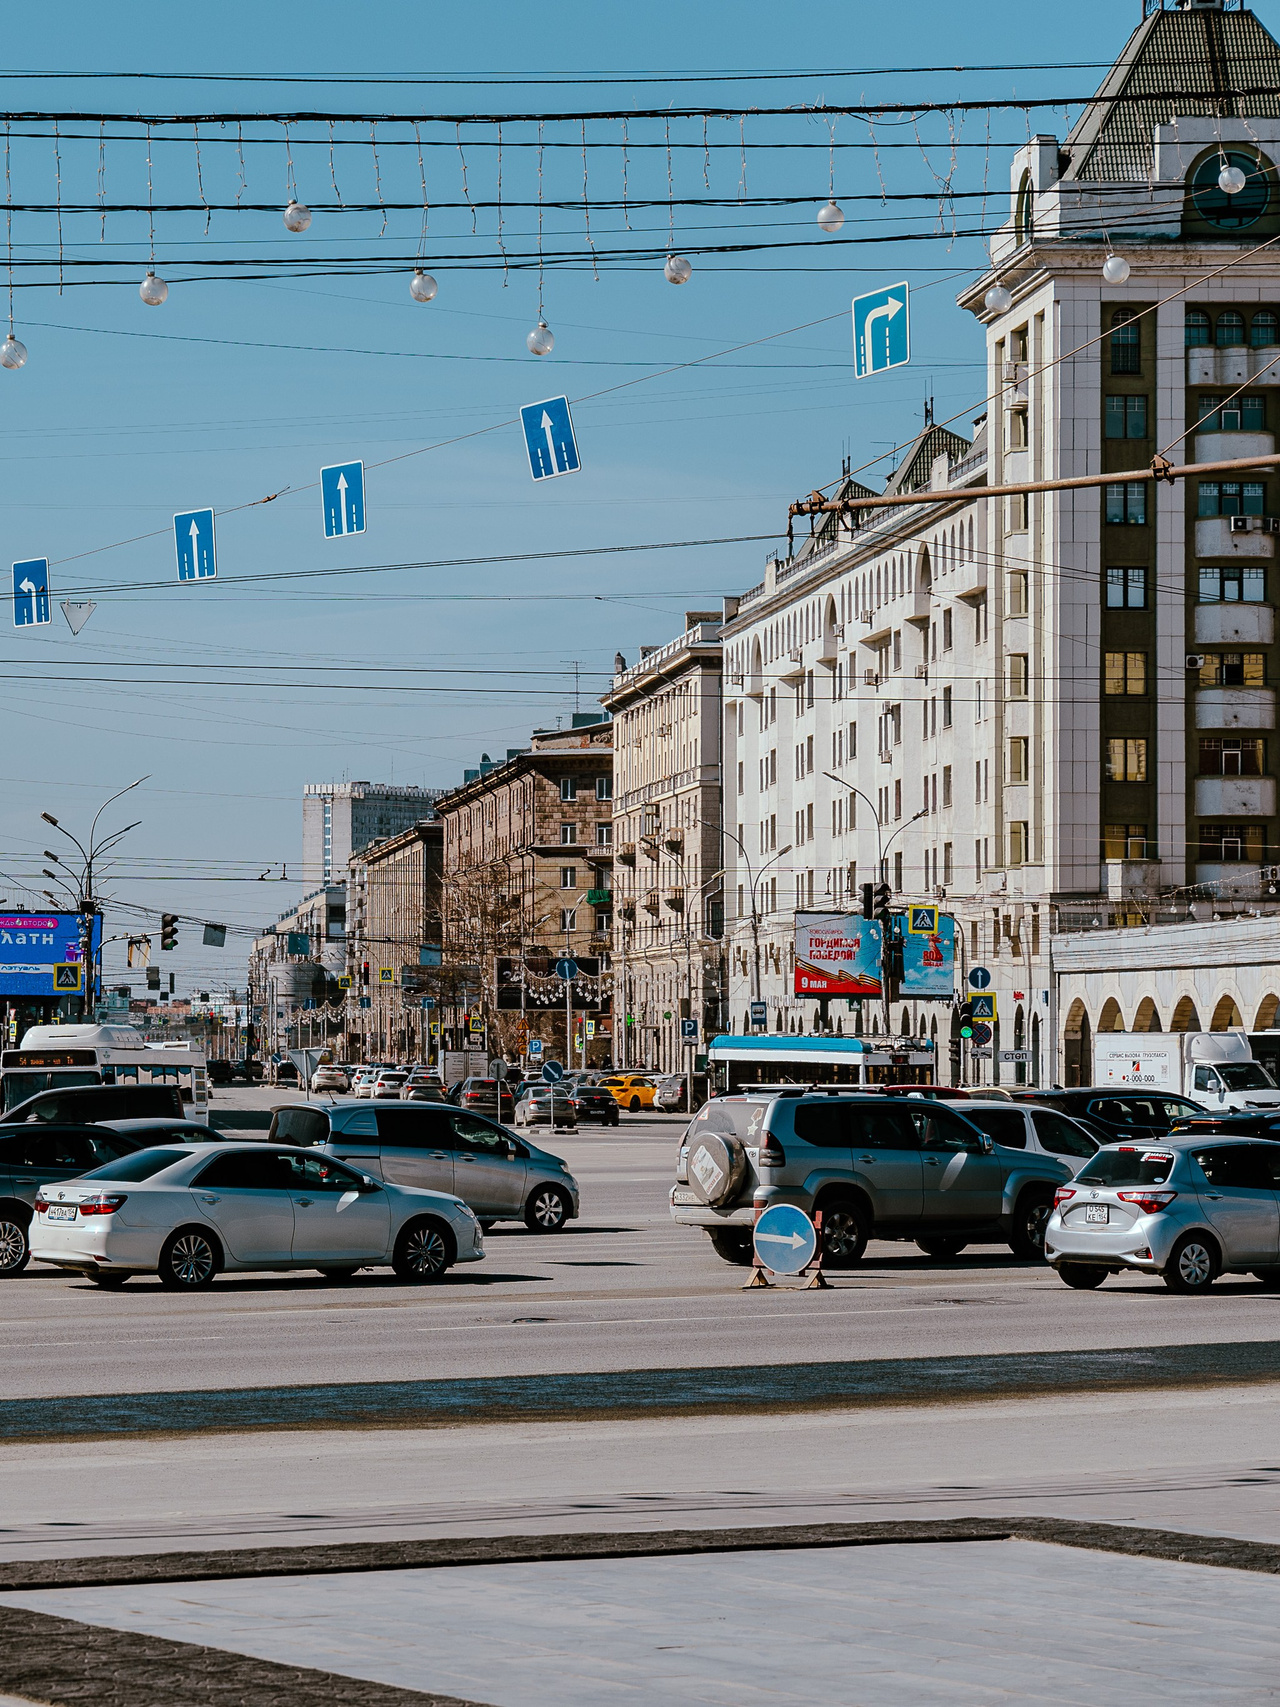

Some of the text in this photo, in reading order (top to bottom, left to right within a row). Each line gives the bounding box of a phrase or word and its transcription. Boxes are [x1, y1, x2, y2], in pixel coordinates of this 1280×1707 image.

[23, 919, 53, 928] второ
[801, 976, 828, 989] 9 МАЯ
[685, 1021, 694, 1034] P
[532, 1041, 540, 1051] P
